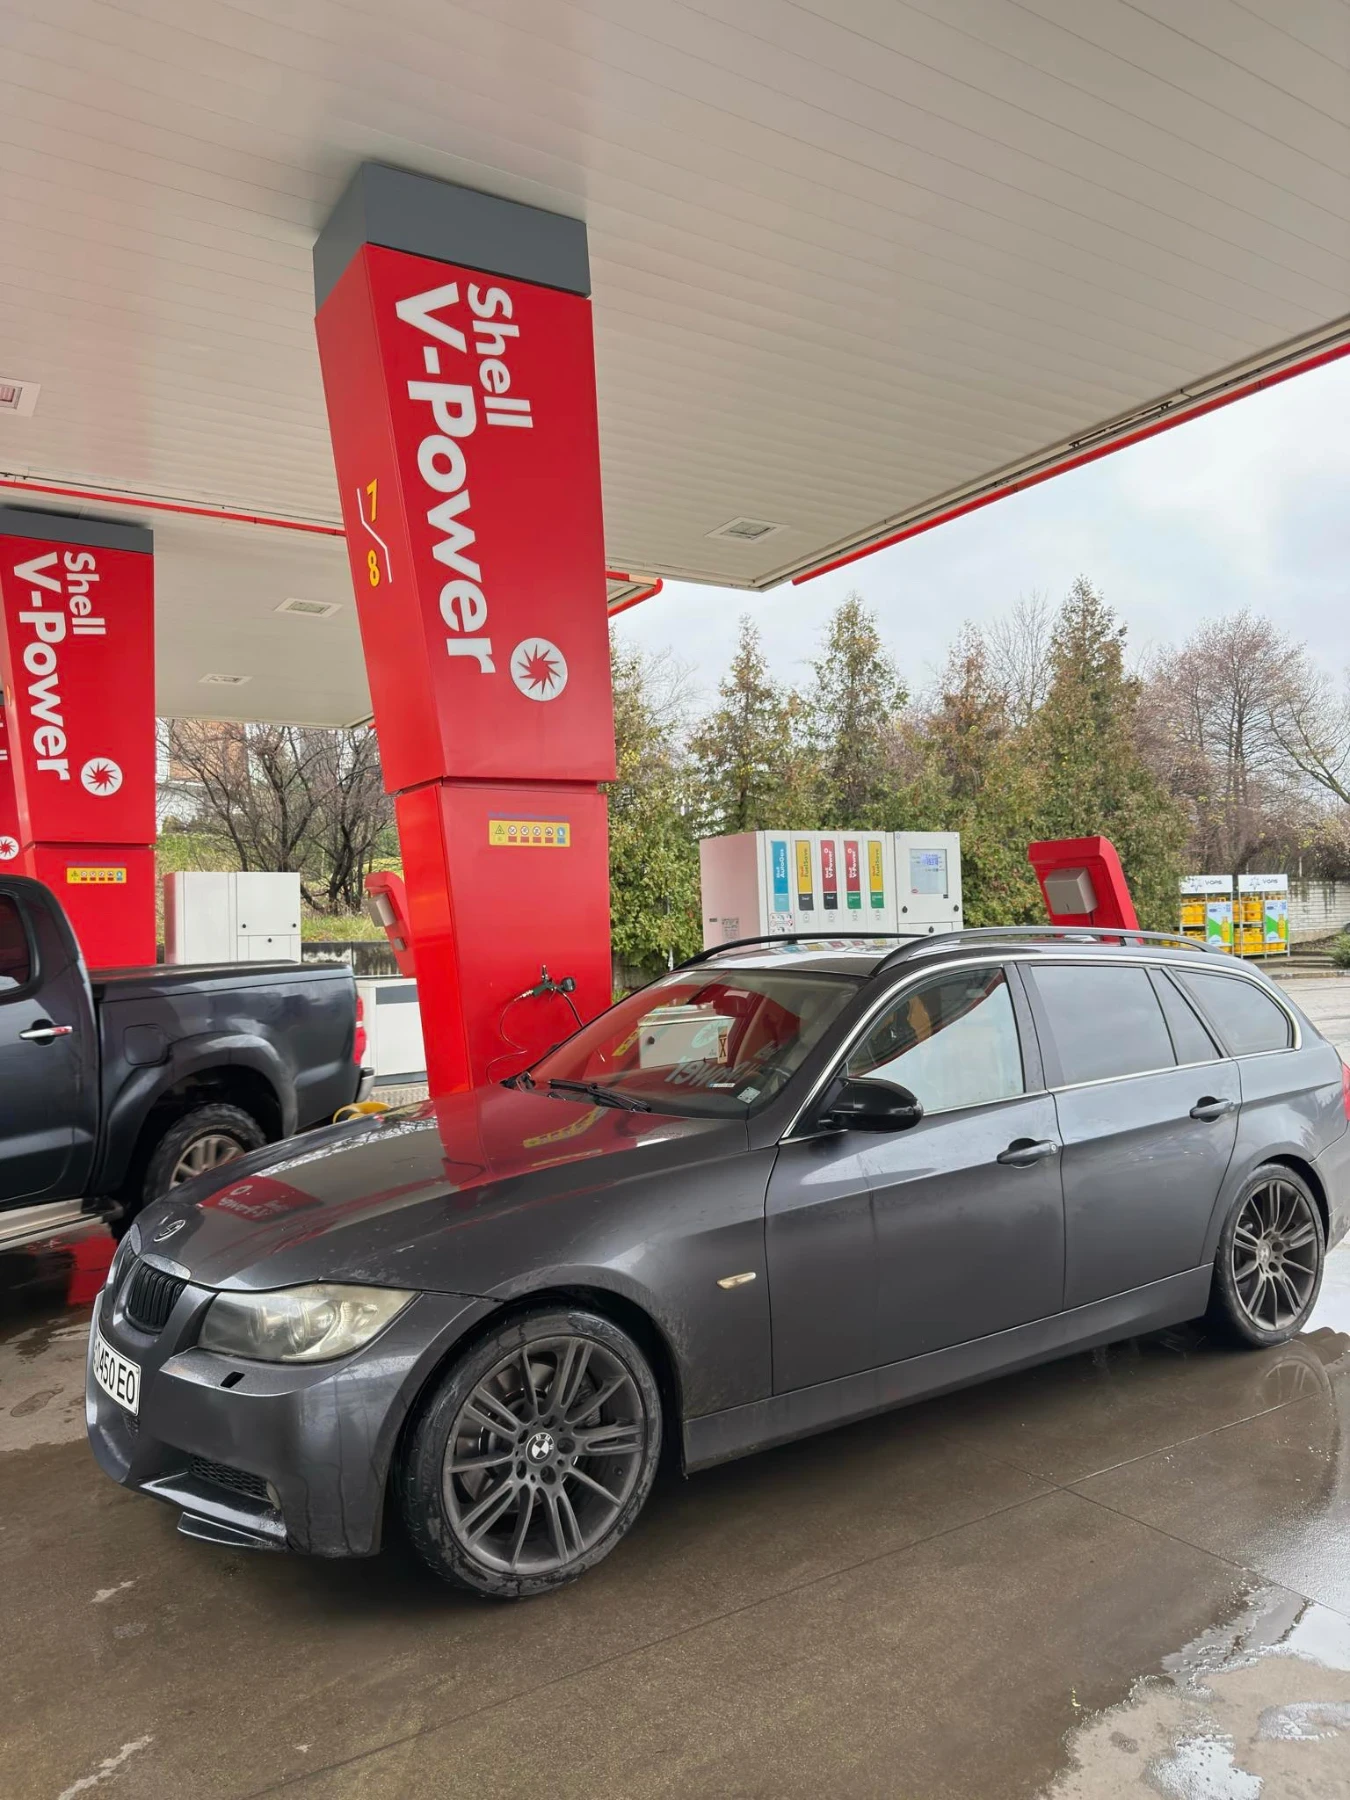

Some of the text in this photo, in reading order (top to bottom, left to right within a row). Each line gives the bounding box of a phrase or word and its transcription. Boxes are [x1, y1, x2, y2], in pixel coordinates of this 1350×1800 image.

[467, 282, 534, 428] Shell
[395, 282, 497, 675] V-Power
[64, 551, 106, 635] Shell
[367, 549, 380, 587] 8
[13, 551, 70, 781] V-Power
